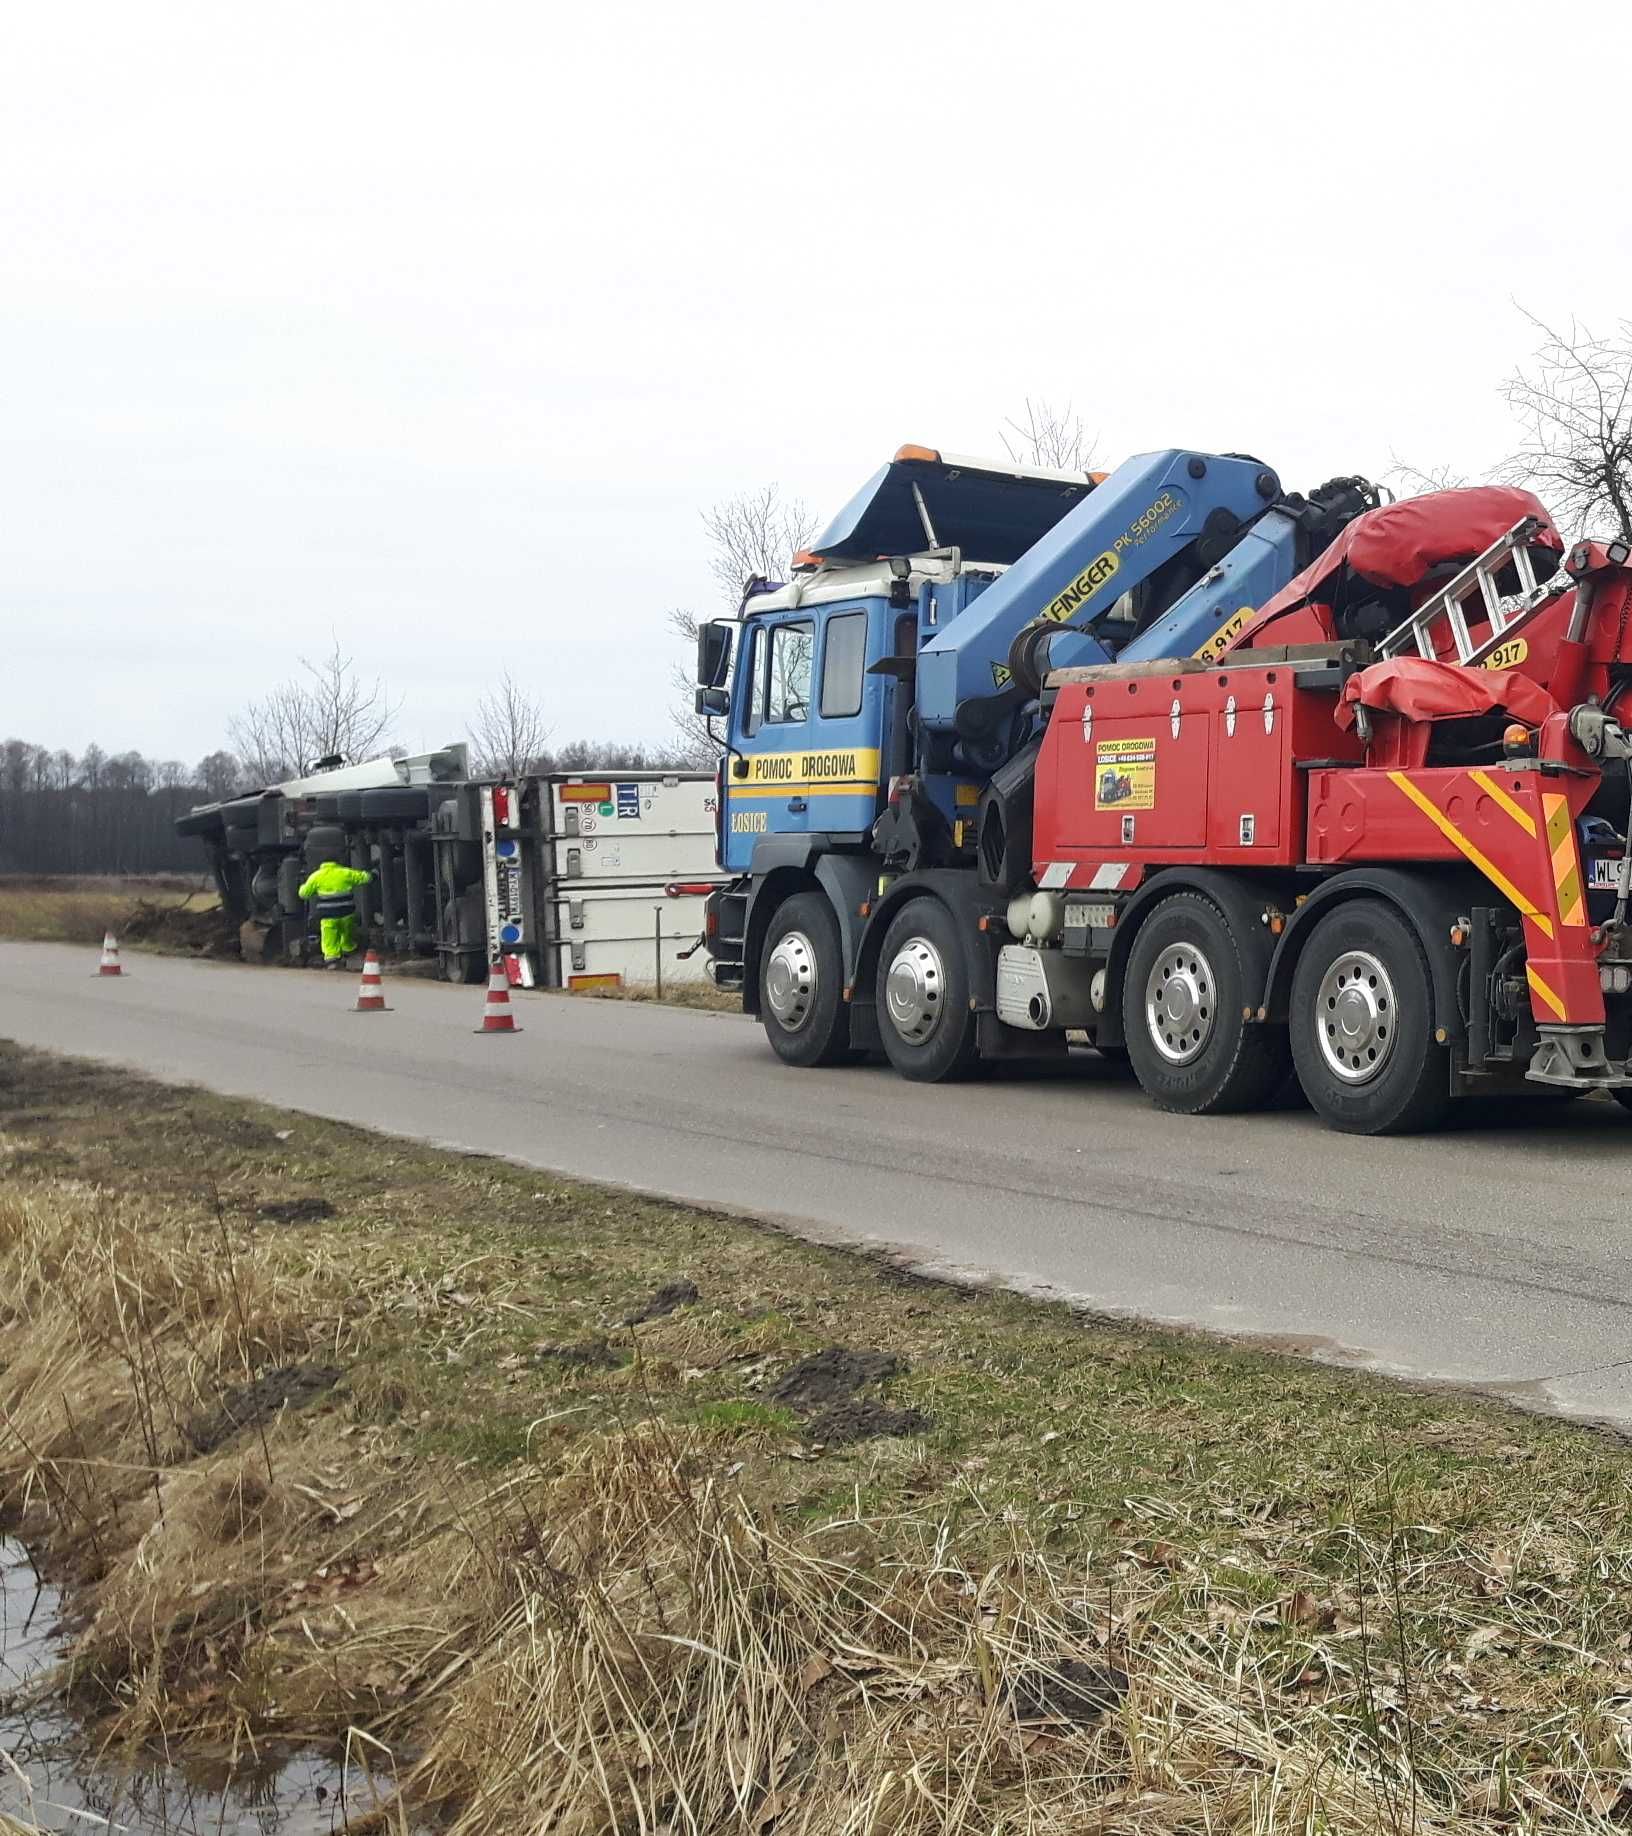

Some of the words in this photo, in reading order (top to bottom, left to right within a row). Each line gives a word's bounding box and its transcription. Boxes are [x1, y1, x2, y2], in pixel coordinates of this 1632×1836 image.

[1113, 532, 1134, 553] PK
[1130, 492, 1173, 536] 56002
[1041, 556, 1115, 622] FINGER
[1214, 617, 1242, 652] 917
[1493, 643, 1521, 668] 917
[1098, 743, 1120, 752] POMOC
[1122, 741, 1153, 750] DROGOWA
[755, 757, 793, 780] POMOC
[801, 754, 856, 777] DROGOWA
[599, 805, 612, 814] L
[617, 786, 638, 816] TIR
[584, 820, 593, 830] 70
